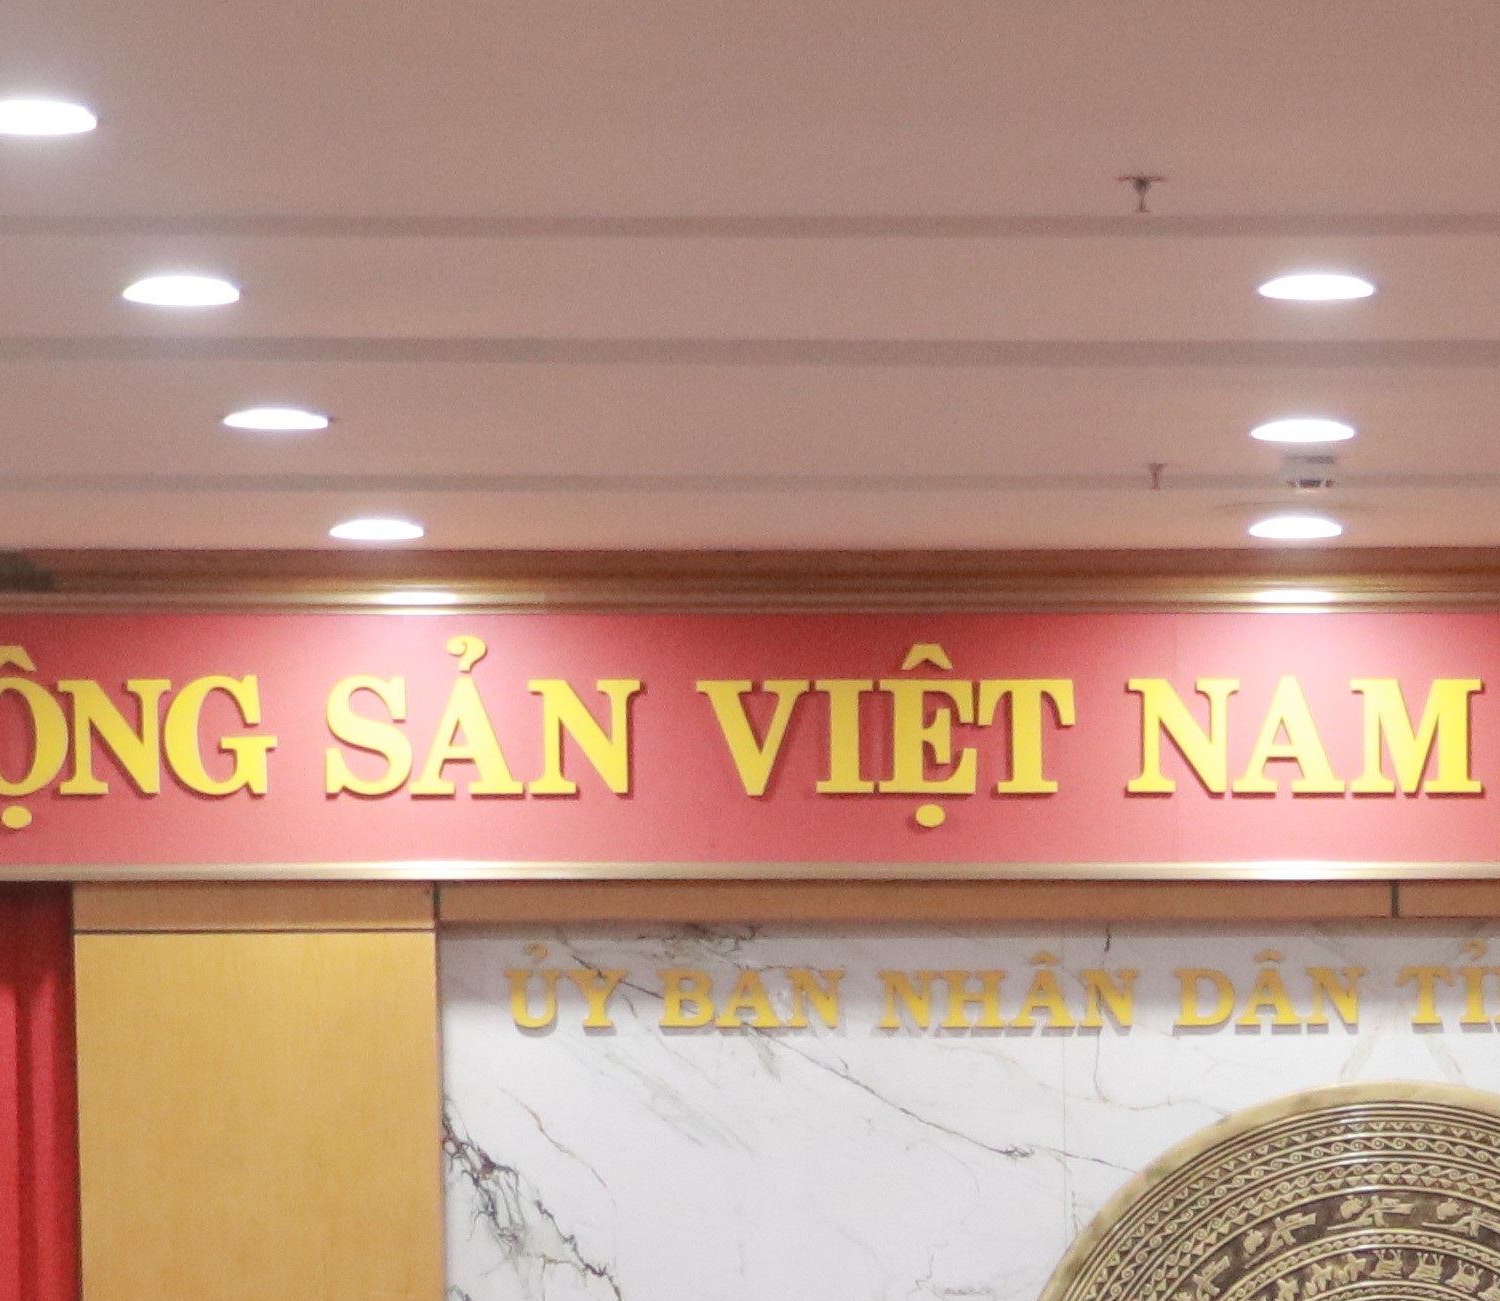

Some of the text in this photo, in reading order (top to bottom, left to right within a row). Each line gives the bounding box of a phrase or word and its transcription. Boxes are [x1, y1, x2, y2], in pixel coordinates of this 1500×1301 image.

[324, 635, 640, 794] SẢN
[696, 645, 1077, 827] VIỆT
[1127, 677, 1483, 793] NAM
[504, 944, 628, 1028] ỦY
[659, 968, 845, 1028] BAN
[878, 952, 1139, 1029] NHÂN
[1175, 950, 1365, 1027] DÂN
